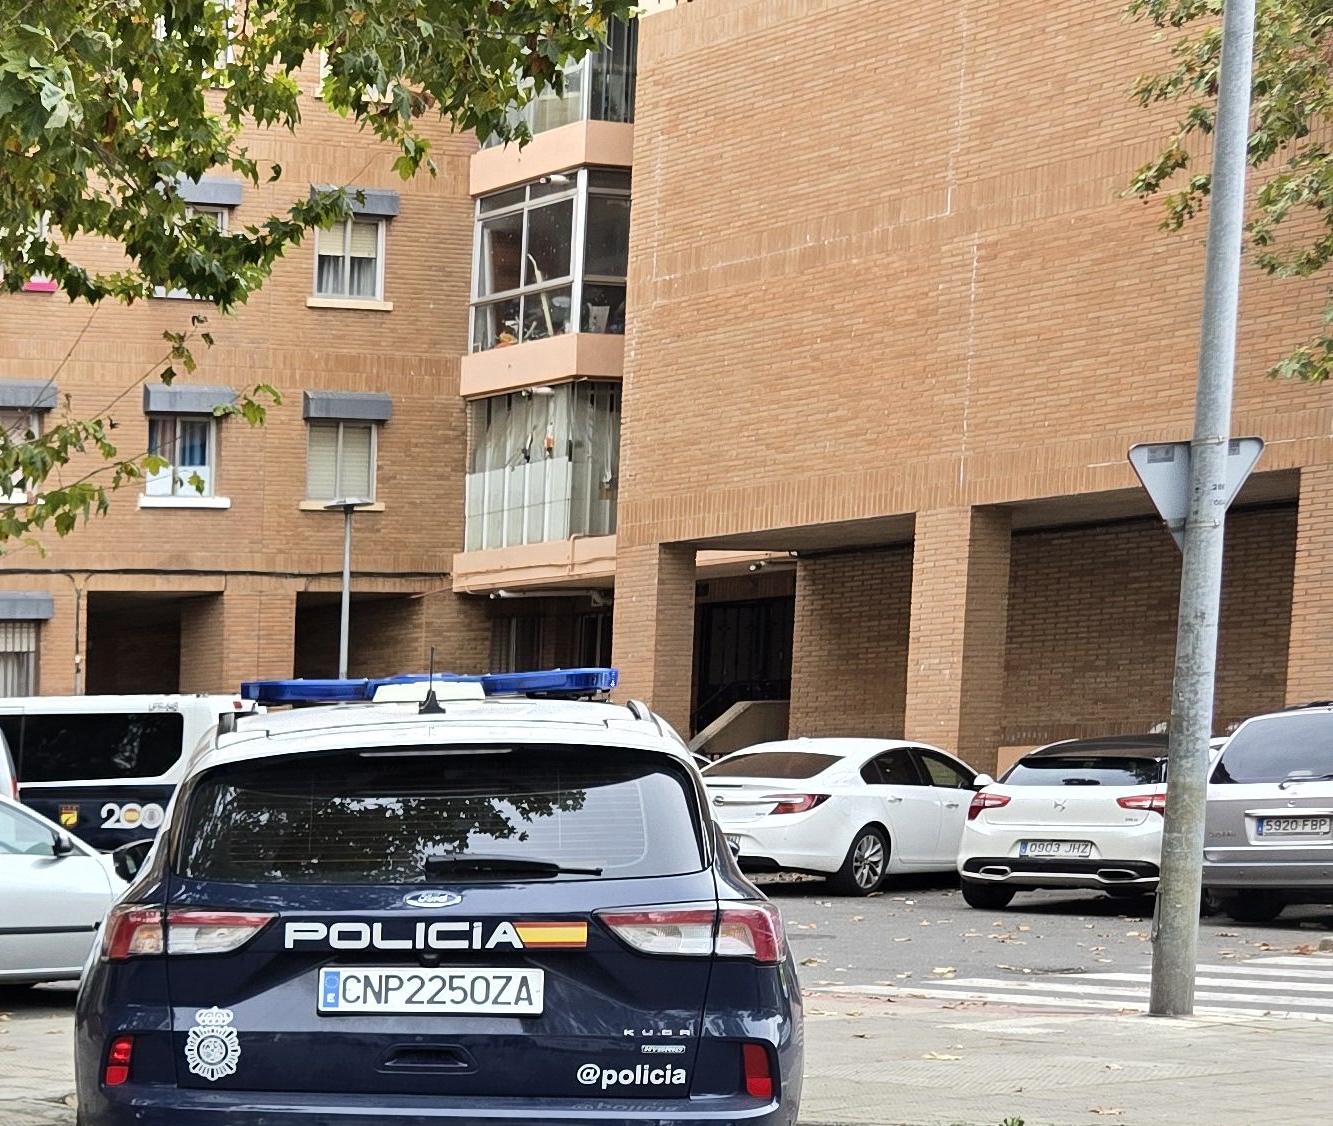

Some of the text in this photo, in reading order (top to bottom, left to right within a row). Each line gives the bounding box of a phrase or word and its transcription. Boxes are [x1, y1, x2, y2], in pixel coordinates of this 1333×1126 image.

[100, 803, 164, 829] 200
[1265, 819, 1327, 831] 5920 FBP
[1029, 843, 1089, 853] 0903 JHZ
[342, 975, 533, 1006] CNP2250ZA
[576, 1063, 686, 1090] @policia
